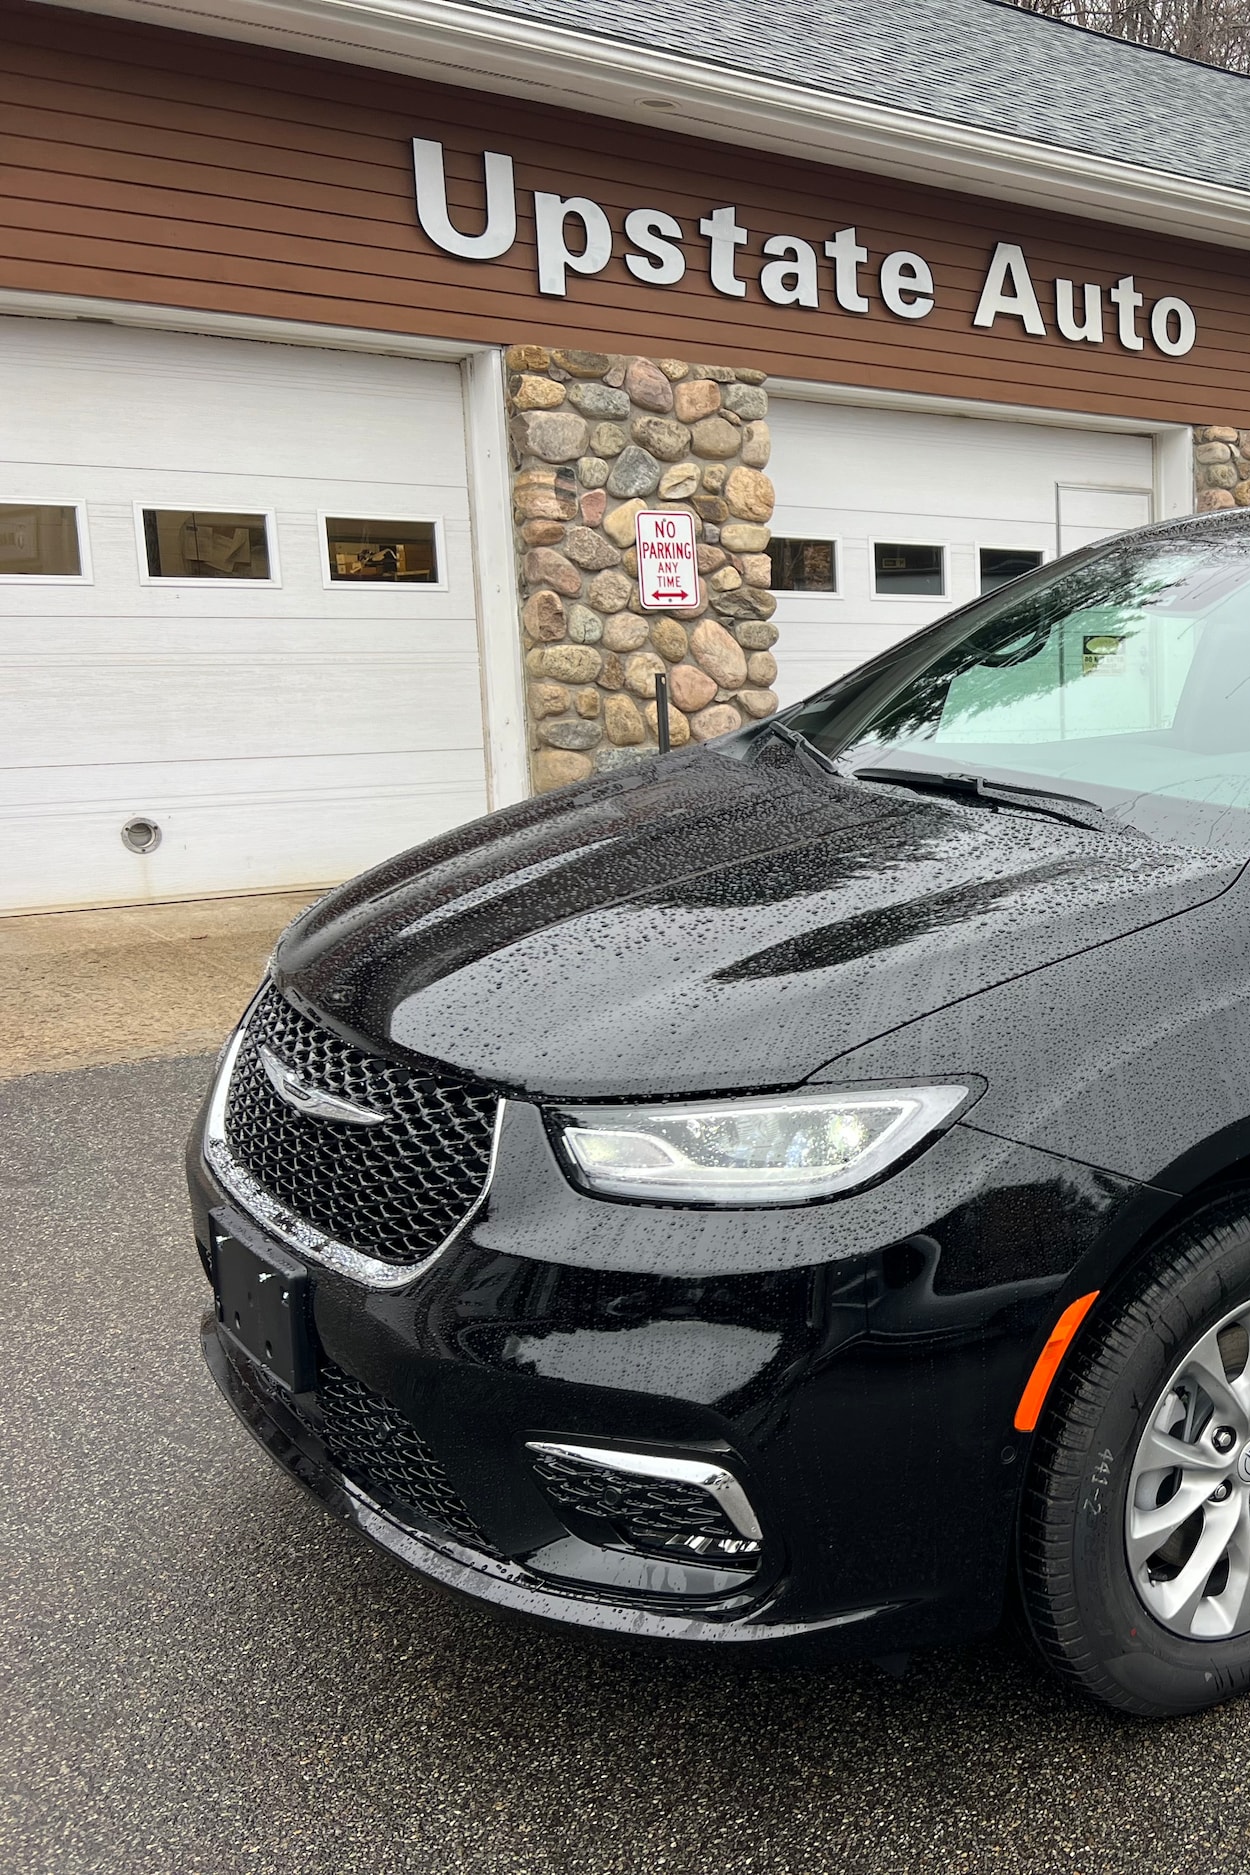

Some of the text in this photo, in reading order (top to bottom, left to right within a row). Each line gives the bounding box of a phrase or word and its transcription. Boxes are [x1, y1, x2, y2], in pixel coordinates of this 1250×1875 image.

[411, 136, 1198, 358] Upstate Auto
[654, 520, 676, 539] NO
[642, 541, 692, 560] PARKING
[657, 561, 679, 574] ANY
[656, 575, 682, 588] TIME
